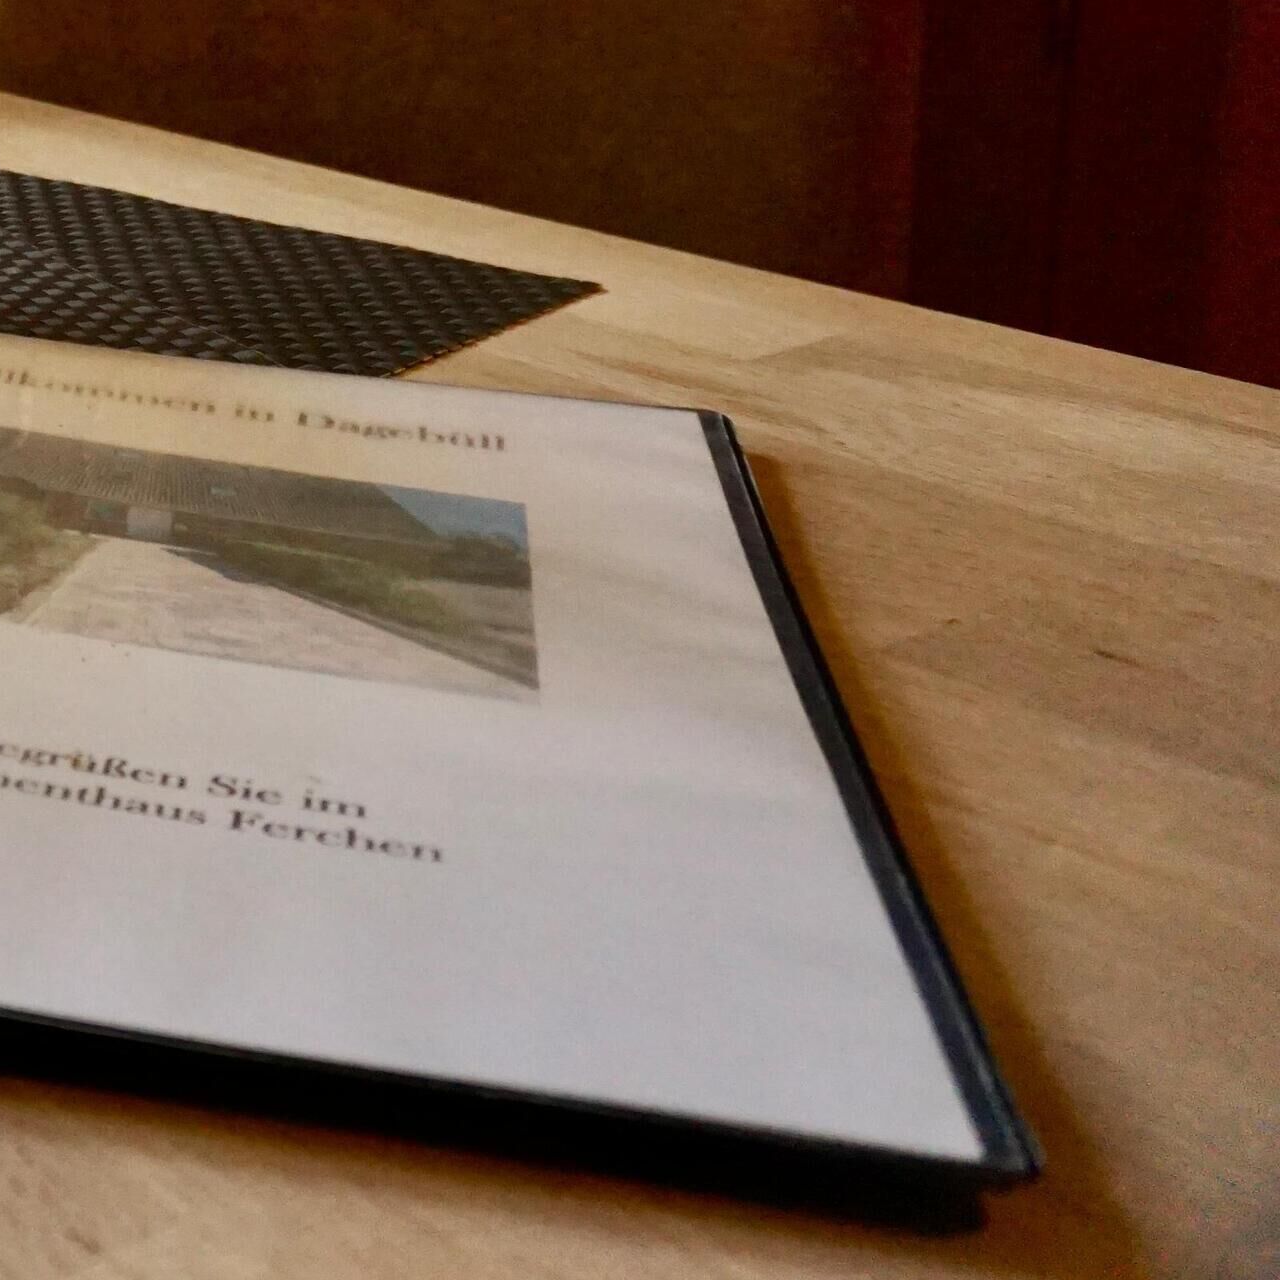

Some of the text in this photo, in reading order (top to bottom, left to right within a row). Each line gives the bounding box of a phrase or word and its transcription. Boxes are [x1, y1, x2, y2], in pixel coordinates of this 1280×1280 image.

[234, 404, 275, 423] in
[207, 773, 283, 806] Sie
[302, 787, 367, 819] im
[230, 809, 443, 863] Ferchen
